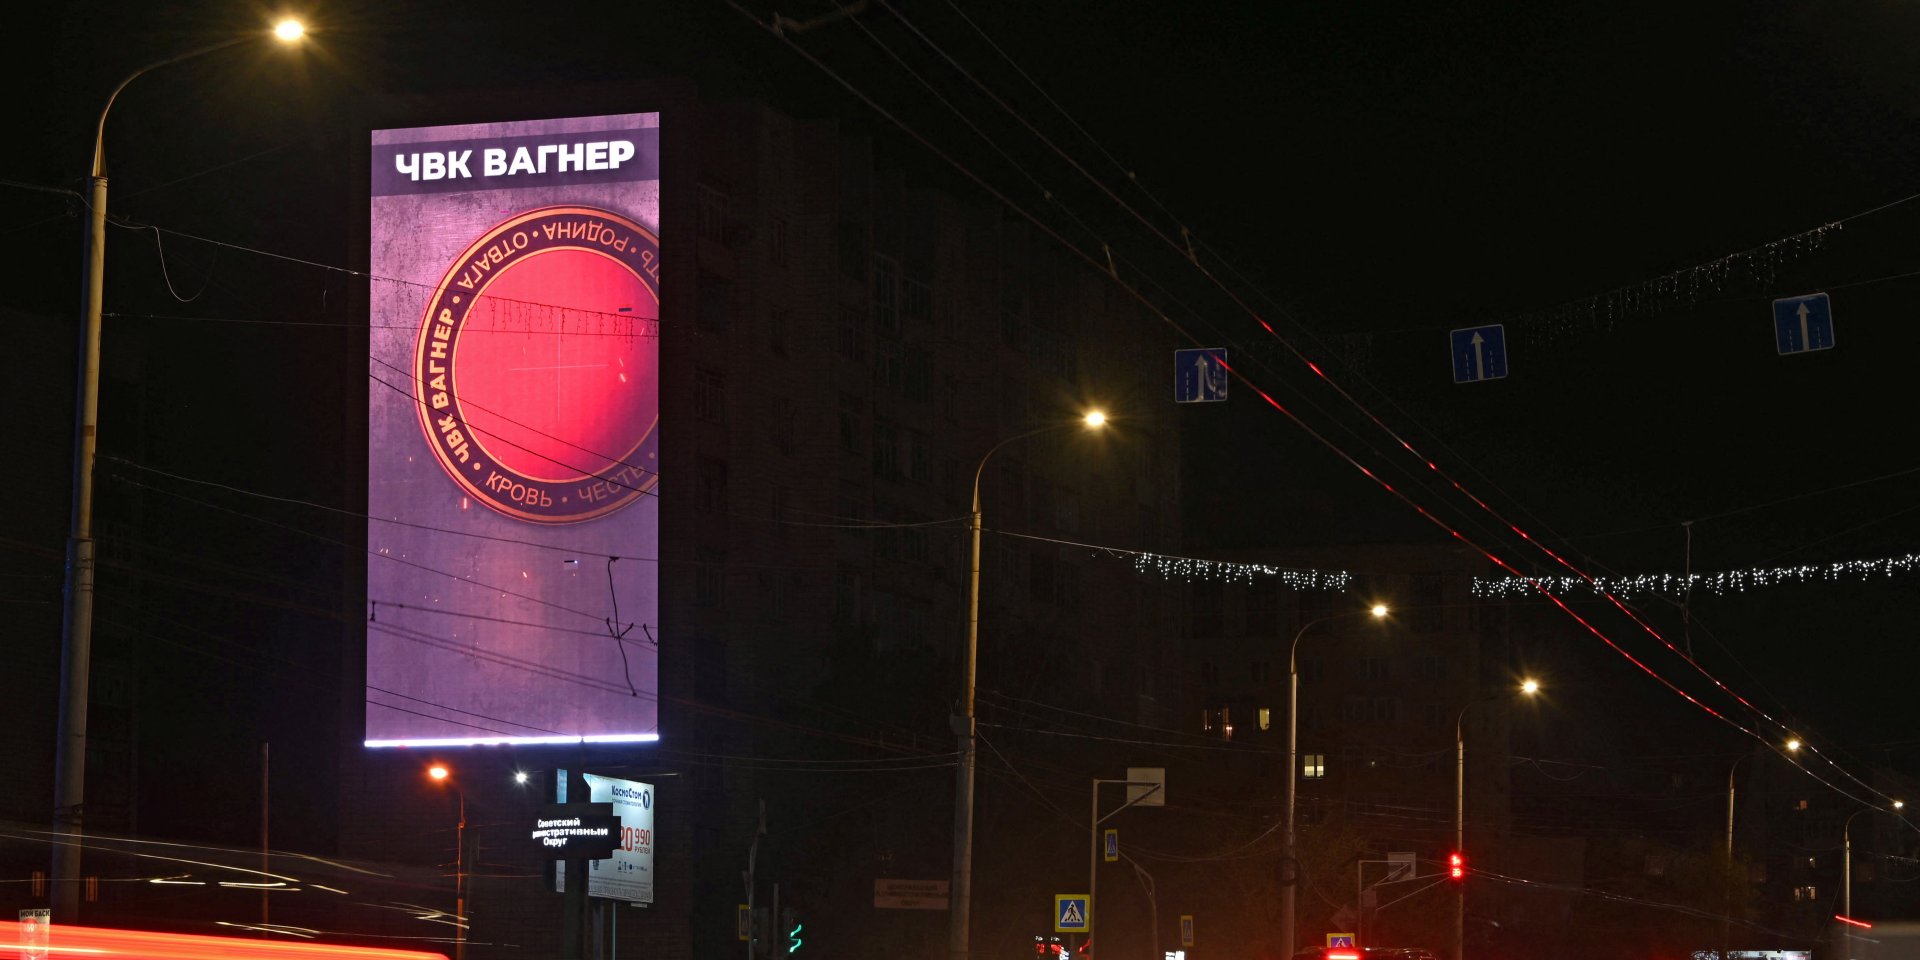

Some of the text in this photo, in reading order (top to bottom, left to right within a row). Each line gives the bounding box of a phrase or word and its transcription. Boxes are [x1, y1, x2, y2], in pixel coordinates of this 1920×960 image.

[395, 140, 635, 182] ЧВК ВАГНЕР
[542, 219, 630, 252] РОДИНА
[456, 231, 529, 289] ОТВАГА
[429, 308, 470, 464] ЧВК ВАГНЕР
[485, 470, 553, 508] КРОВЬ
[578, 465, 646, 504] ЧЕСТЬ
[537, 817, 581, 829] Советский
[635, 828, 650, 846] 990
[543, 837, 568, 848] Округ
